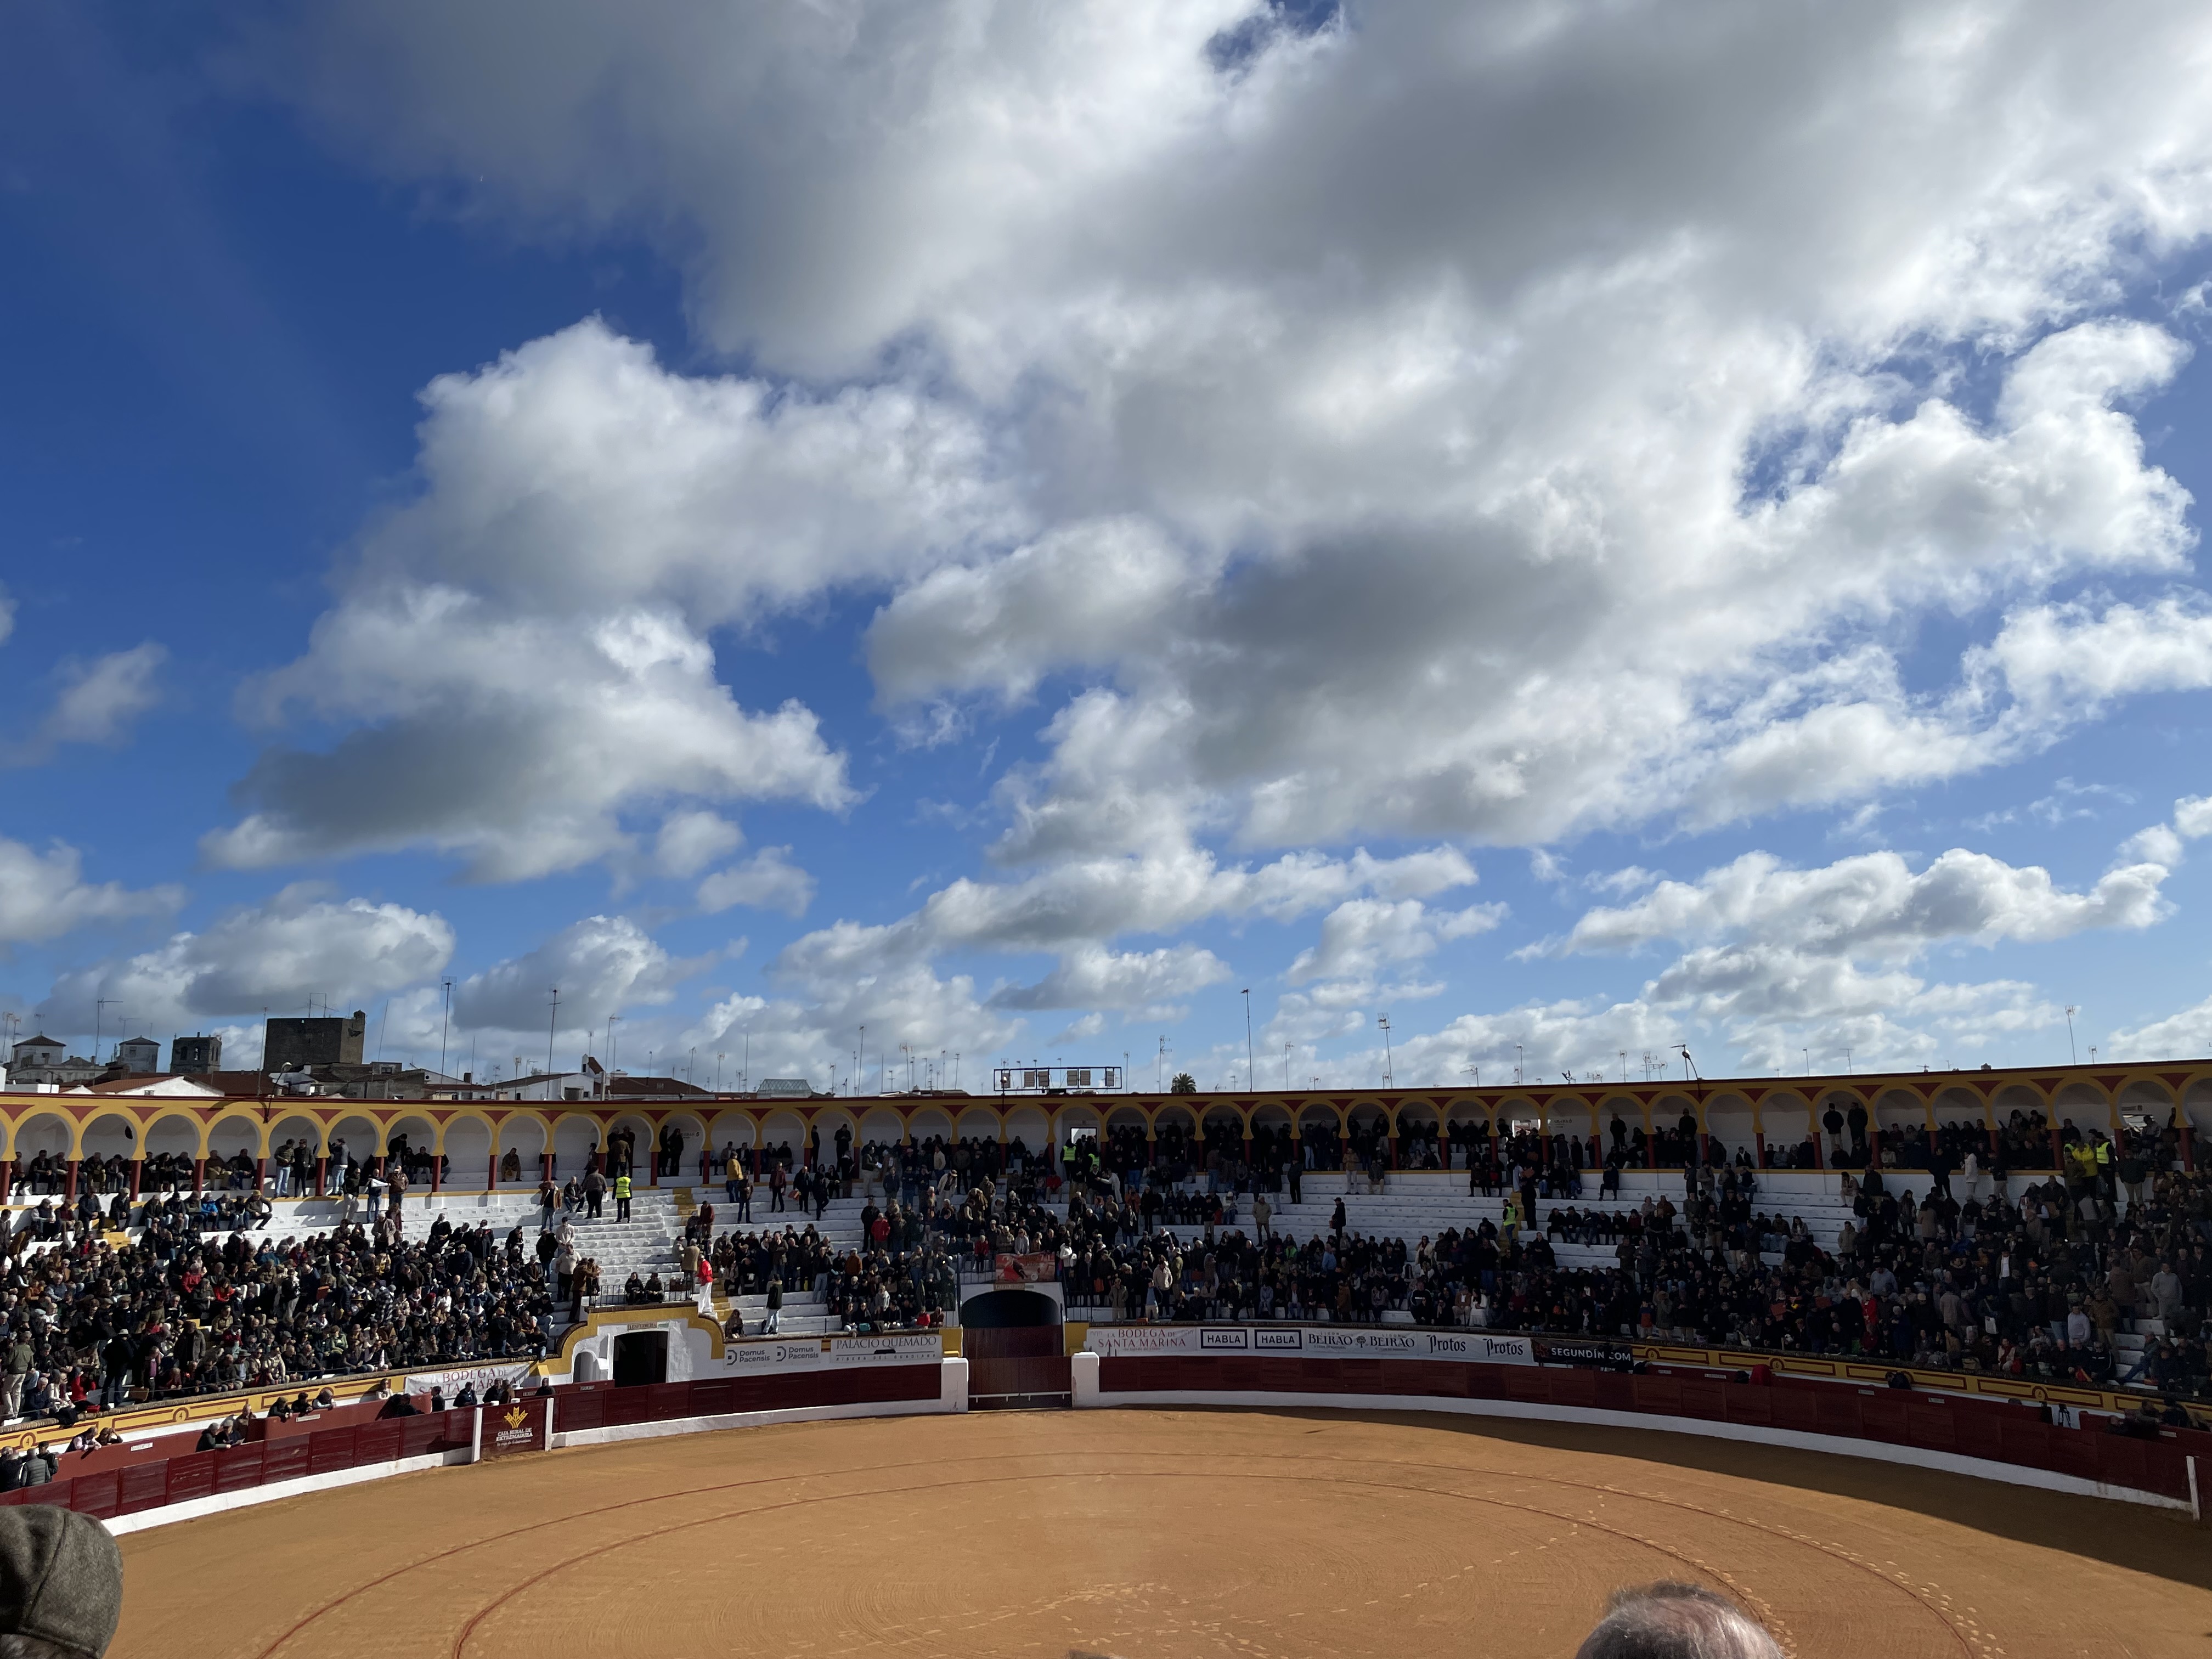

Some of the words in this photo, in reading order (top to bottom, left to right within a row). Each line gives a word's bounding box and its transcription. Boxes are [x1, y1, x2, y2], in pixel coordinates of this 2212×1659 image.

[1118, 1329, 1165, 1338] BODEGA
[1207, 1335, 1241, 1344] HABLA
[1261, 1335, 1295, 1344] HABLA
[837, 1339, 880, 1350] PALACIO
[882, 1336, 936, 1348] QUEMADO
[1098, 1338, 1135, 1348] SANTA
[1139, 1338, 1186, 1347] MARINA
[1308, 1334, 1353, 1346] BEIRÃO
[1370, 1336, 1415, 1348] BEIRÃO
[1426, 1335, 1466, 1353] Protos
[1482, 1338, 1523, 1357] Protos
[443, 1368, 495, 1383] BODEGA
